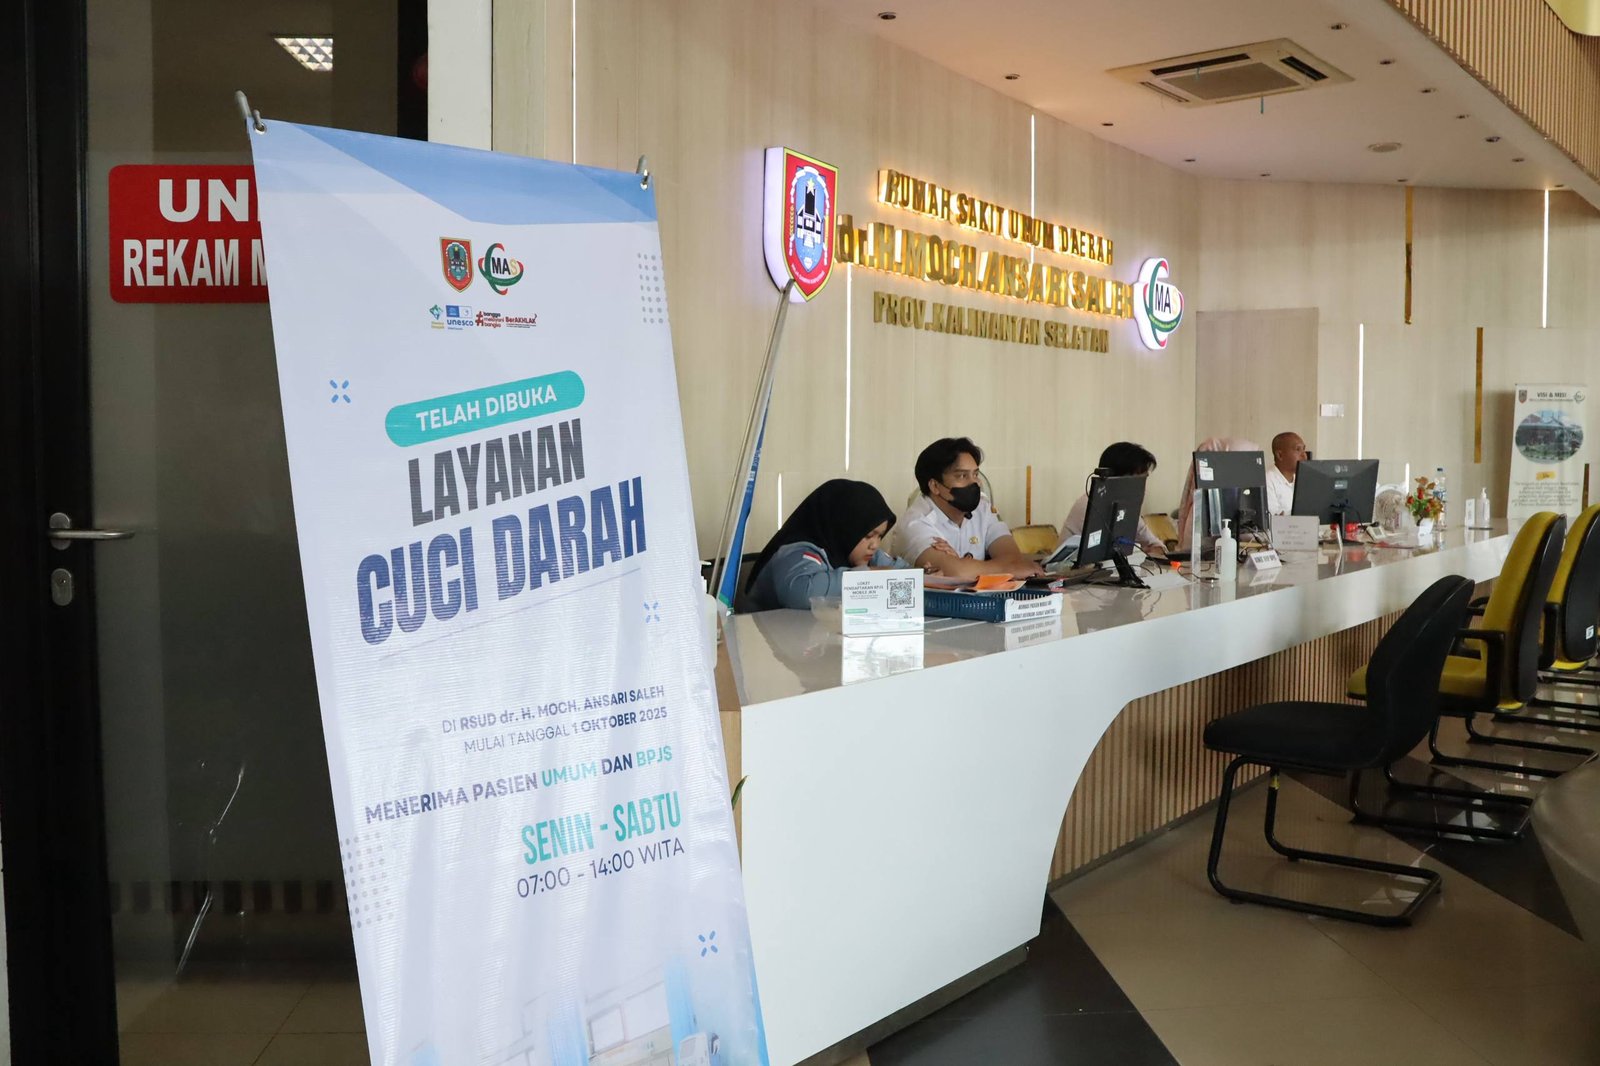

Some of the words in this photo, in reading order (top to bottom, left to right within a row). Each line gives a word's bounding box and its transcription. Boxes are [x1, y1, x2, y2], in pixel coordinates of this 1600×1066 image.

[879, 169, 950, 222] RUMAH
[953, 193, 1005, 236] SAKIT
[1005, 208, 1054, 251] UMUM
[1057, 225, 1113, 266] DAERAH
[123, 239, 239, 287] REKAM
[491, 256, 518, 276] MAS
[1070, 270, 1134, 319] SALEH
[447, 319, 474, 327] unesco
[1043, 320, 1110, 353] SELATAN
[415, 400, 480, 432] TELAH
[485, 384, 557, 418] DIBUKA
[408, 417, 585, 527] LAYANAN
[356, 526, 478, 645] CUCI
[492, 475, 647, 601] DARAH
[442, 719, 457, 734] DI
[460, 712, 497, 731] RSUD
[500, 709, 519, 725] dr.
[521, 707, 535, 720] H.
[537, 700, 581, 718] MOCH.
[583, 691, 627, 711] ANSARI
[629, 685, 665, 702] SALEH
[464, 734, 505, 754] MULAI
[510, 723, 570, 746] TANGGAL
[573, 722, 579, 734] 1
[581, 712, 637, 733] OKTOBER
[639, 706, 668, 723] 2025
[365, 787, 469, 824] MENERIMA
[472, 772, 539, 801] PASIEN
[542, 761, 598, 787] UMUM
[602, 753, 633, 775] DAN
[636, 745, 673, 767] BPJS
[521, 812, 595, 865] SENIN
[613, 790, 682, 842] SABTU
[517, 867, 571, 898] 07:00
[589, 850, 634, 880] 14:00
[638, 837, 685, 865] WITA
